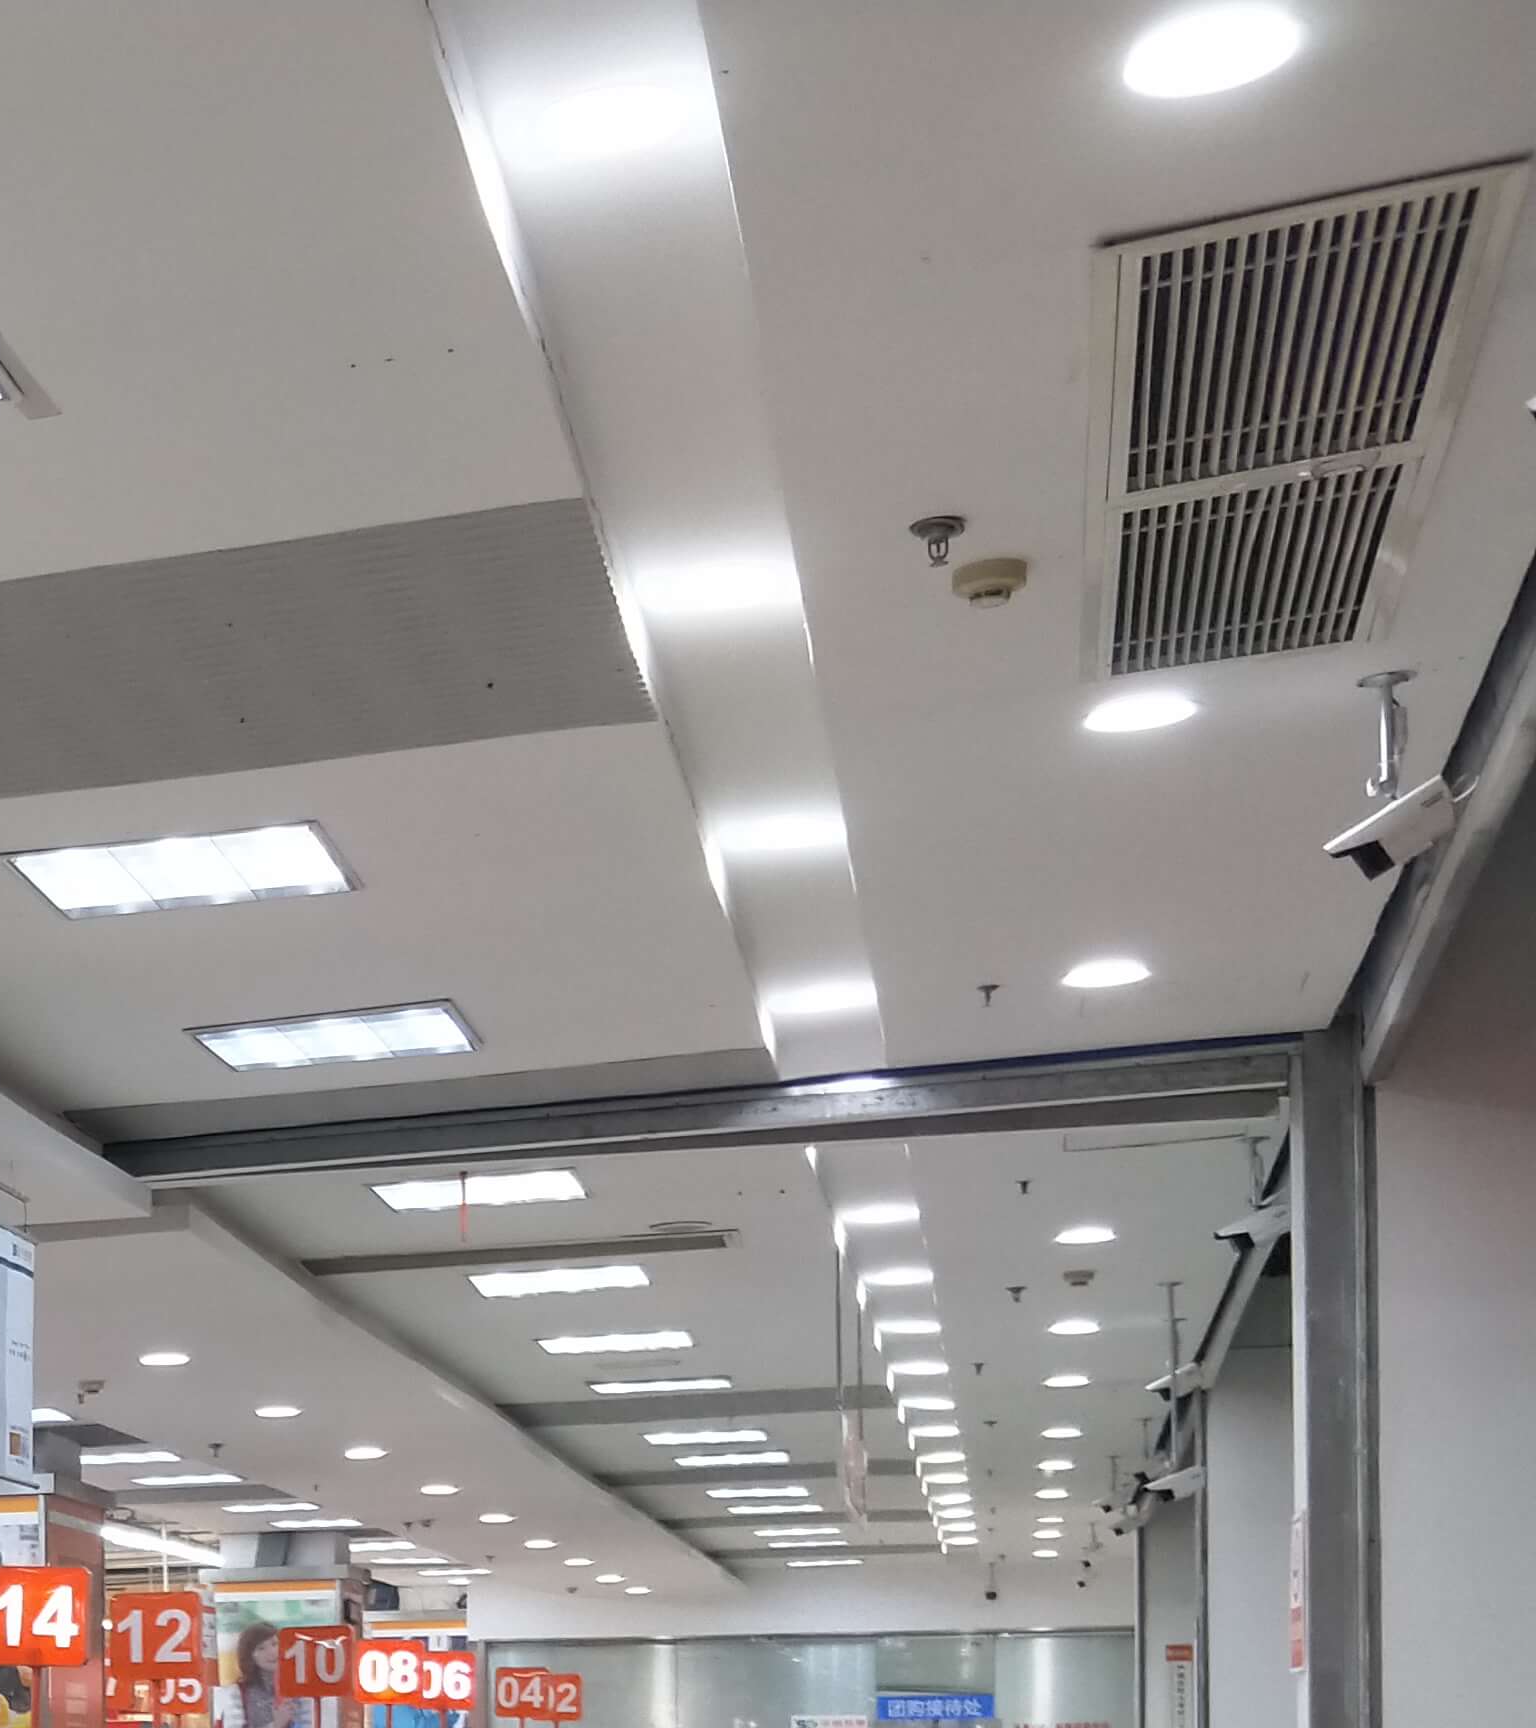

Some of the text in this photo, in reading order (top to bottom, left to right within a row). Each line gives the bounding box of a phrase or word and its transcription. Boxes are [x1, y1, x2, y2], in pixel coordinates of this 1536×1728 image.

[117, 1608, 192, 1663] 12
[284, 1639, 346, 1685] 10
[358, 1650, 419, 1694] 08
[497, 1675, 545, 1709] 04
